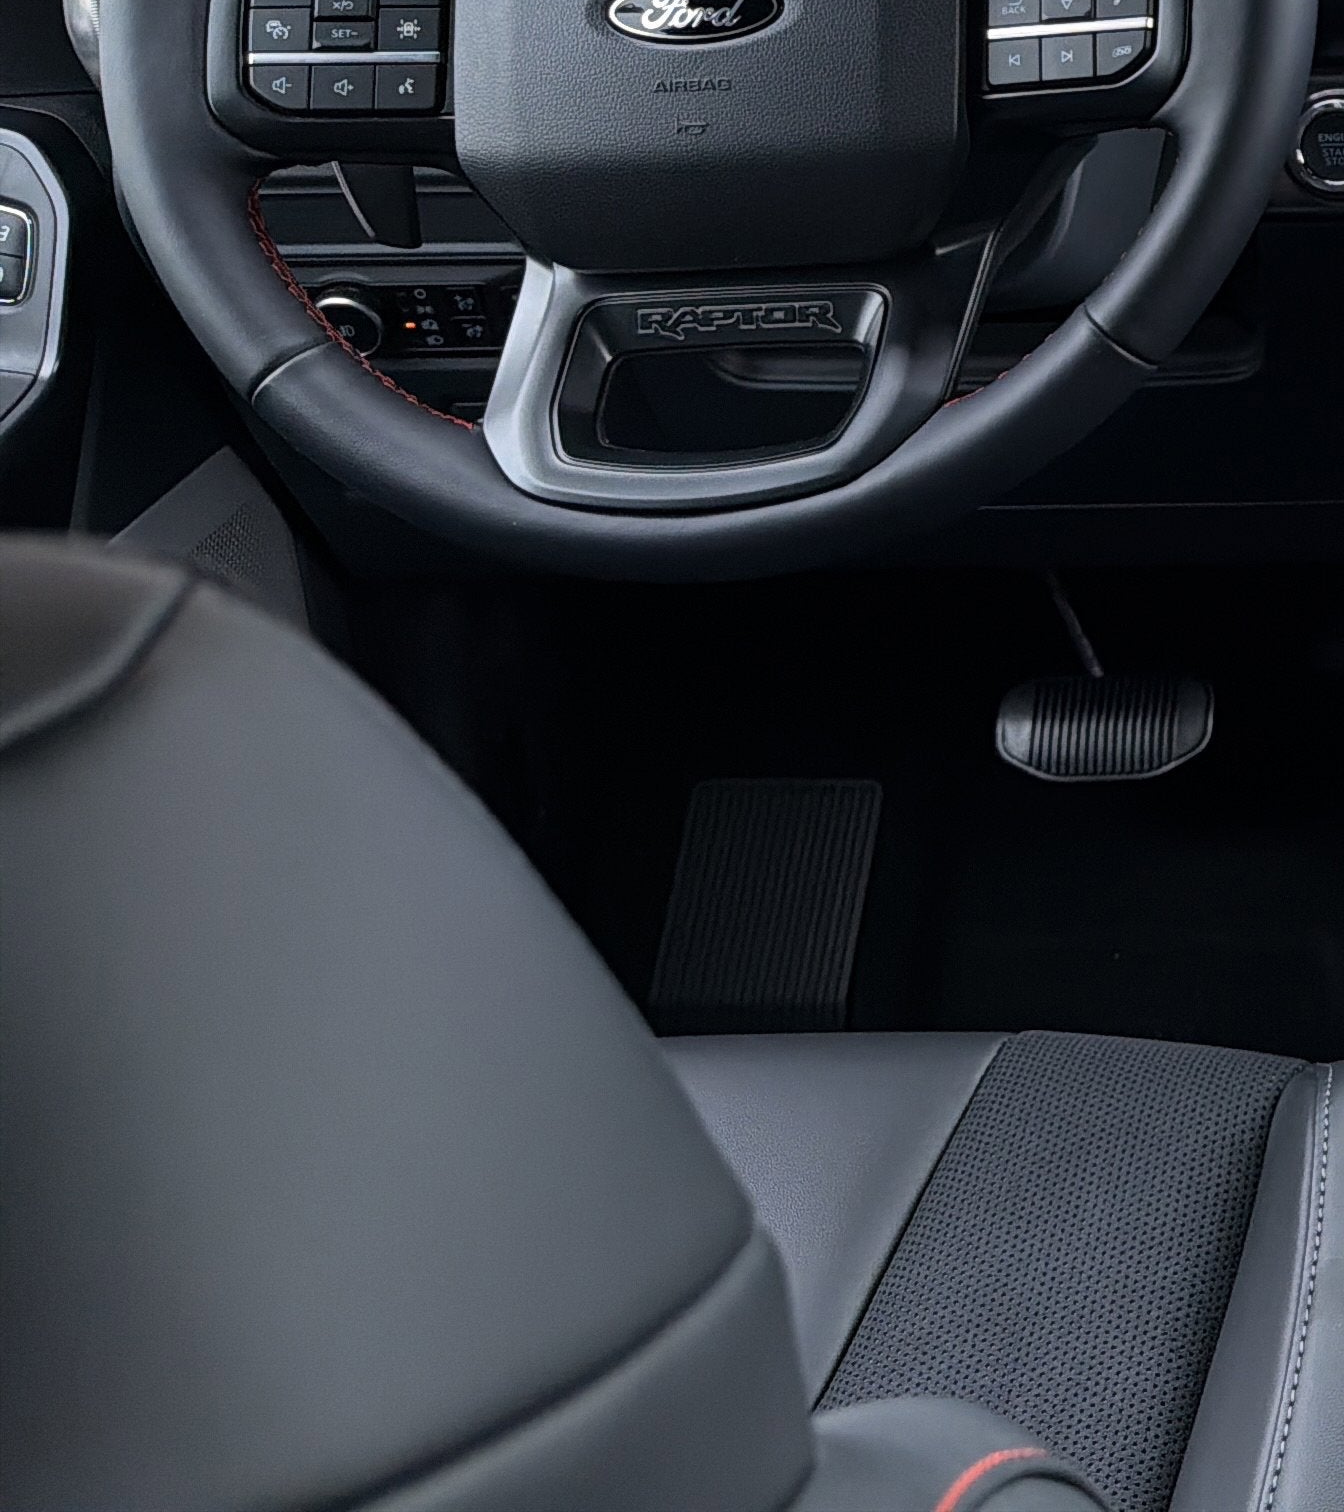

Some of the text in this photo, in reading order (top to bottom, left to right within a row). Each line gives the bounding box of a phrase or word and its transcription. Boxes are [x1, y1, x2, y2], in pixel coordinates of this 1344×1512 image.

[1001, 6, 1026, 15] BACK
[653, 79, 732, 93] AIRBAG
[637, 301, 842, 340] RAPTOR
